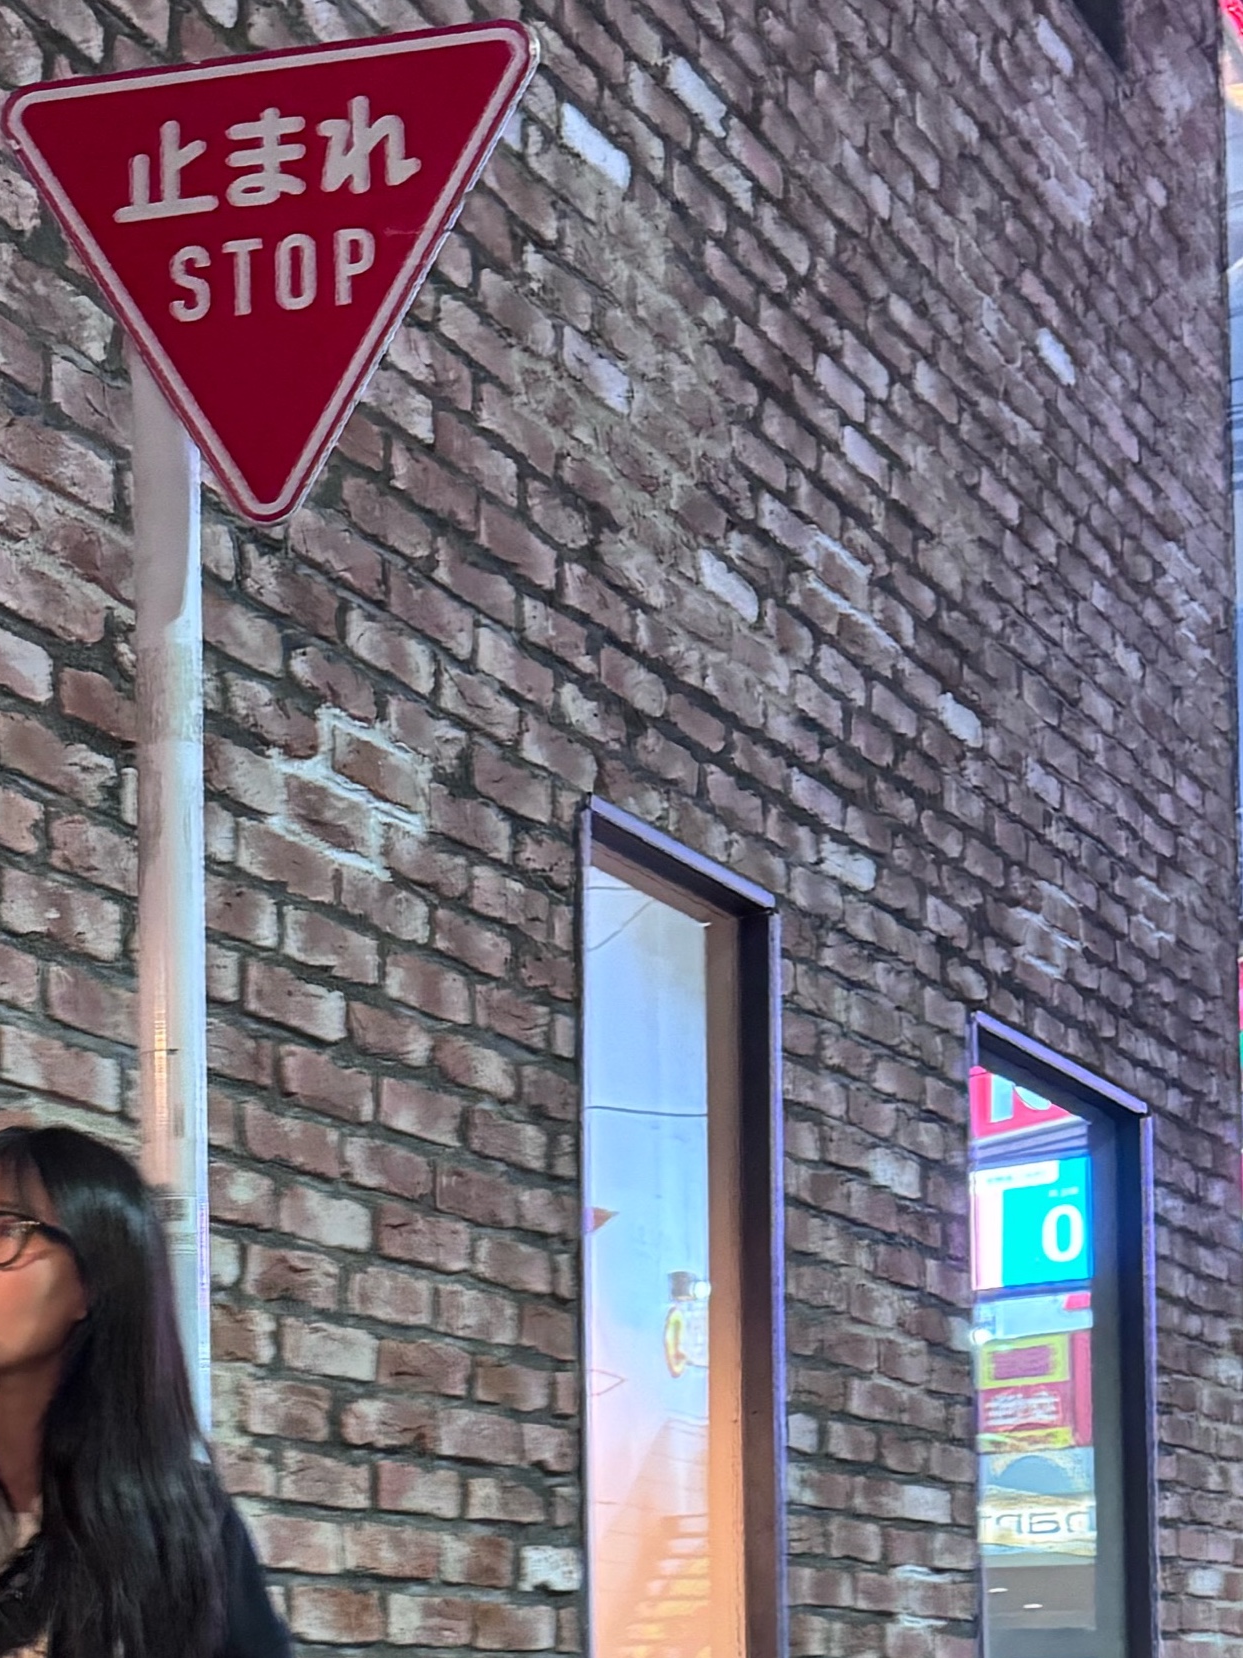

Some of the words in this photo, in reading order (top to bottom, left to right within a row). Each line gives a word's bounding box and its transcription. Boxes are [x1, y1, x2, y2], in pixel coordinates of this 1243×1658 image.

[113, 95, 422, 223] 止まれ
[169, 228, 376, 323] STOP
